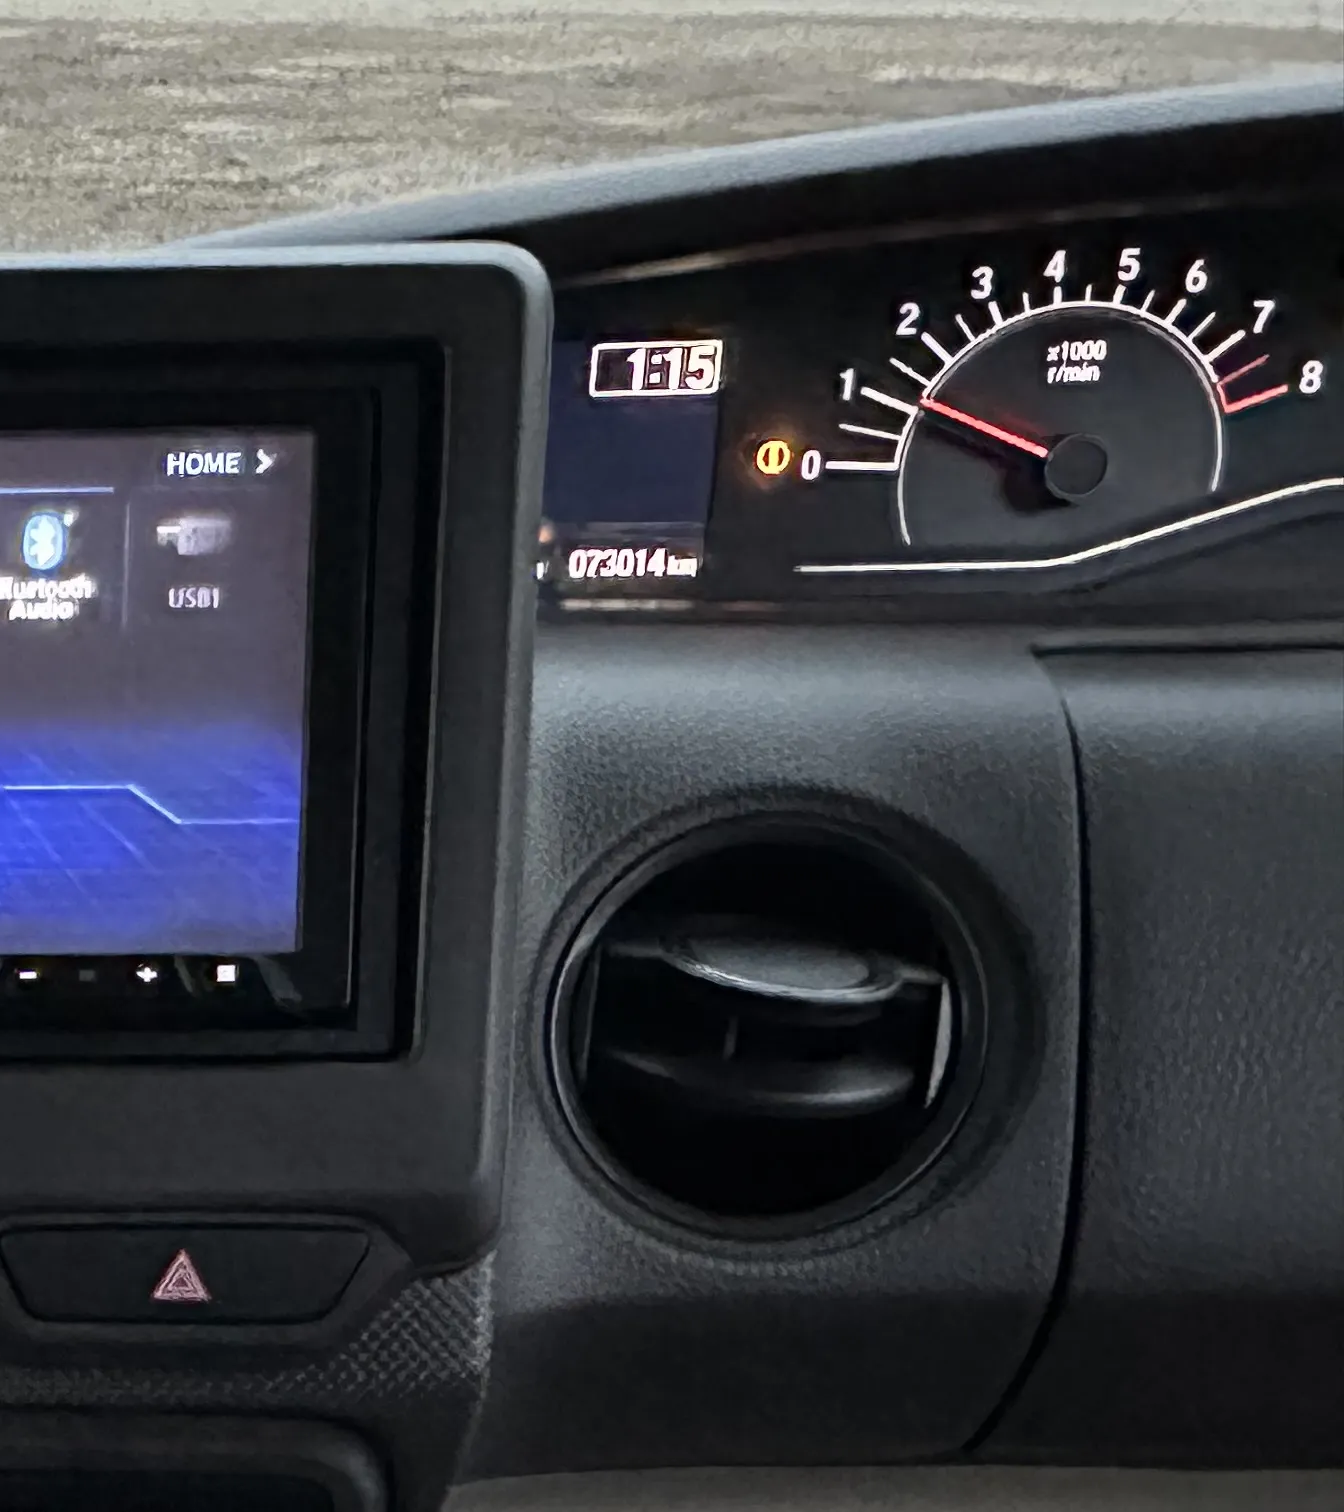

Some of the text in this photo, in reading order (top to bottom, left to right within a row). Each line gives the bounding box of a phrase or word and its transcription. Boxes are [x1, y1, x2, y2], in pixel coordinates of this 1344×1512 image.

[1044, 250, 1066, 282] 4
[1118, 248, 1141, 281] 5
[1186, 259, 1208, 293] 6
[971, 266, 994, 299] 3
[896, 303, 920, 335] 2
[1253, 300, 1275, 333] 7
[627, 346, 716, 391] 1:15
[839, 368, 854, 400] 1
[1046, 362, 1101, 383] r/min
[1299, 360, 1324, 393] 8
[166, 451, 243, 475] HOME
[801, 449, 822, 480] 0
[568, 548, 667, 579] 073014
[8, 601, 78, 621] Audio
[168, 587, 221, 609] USB1
